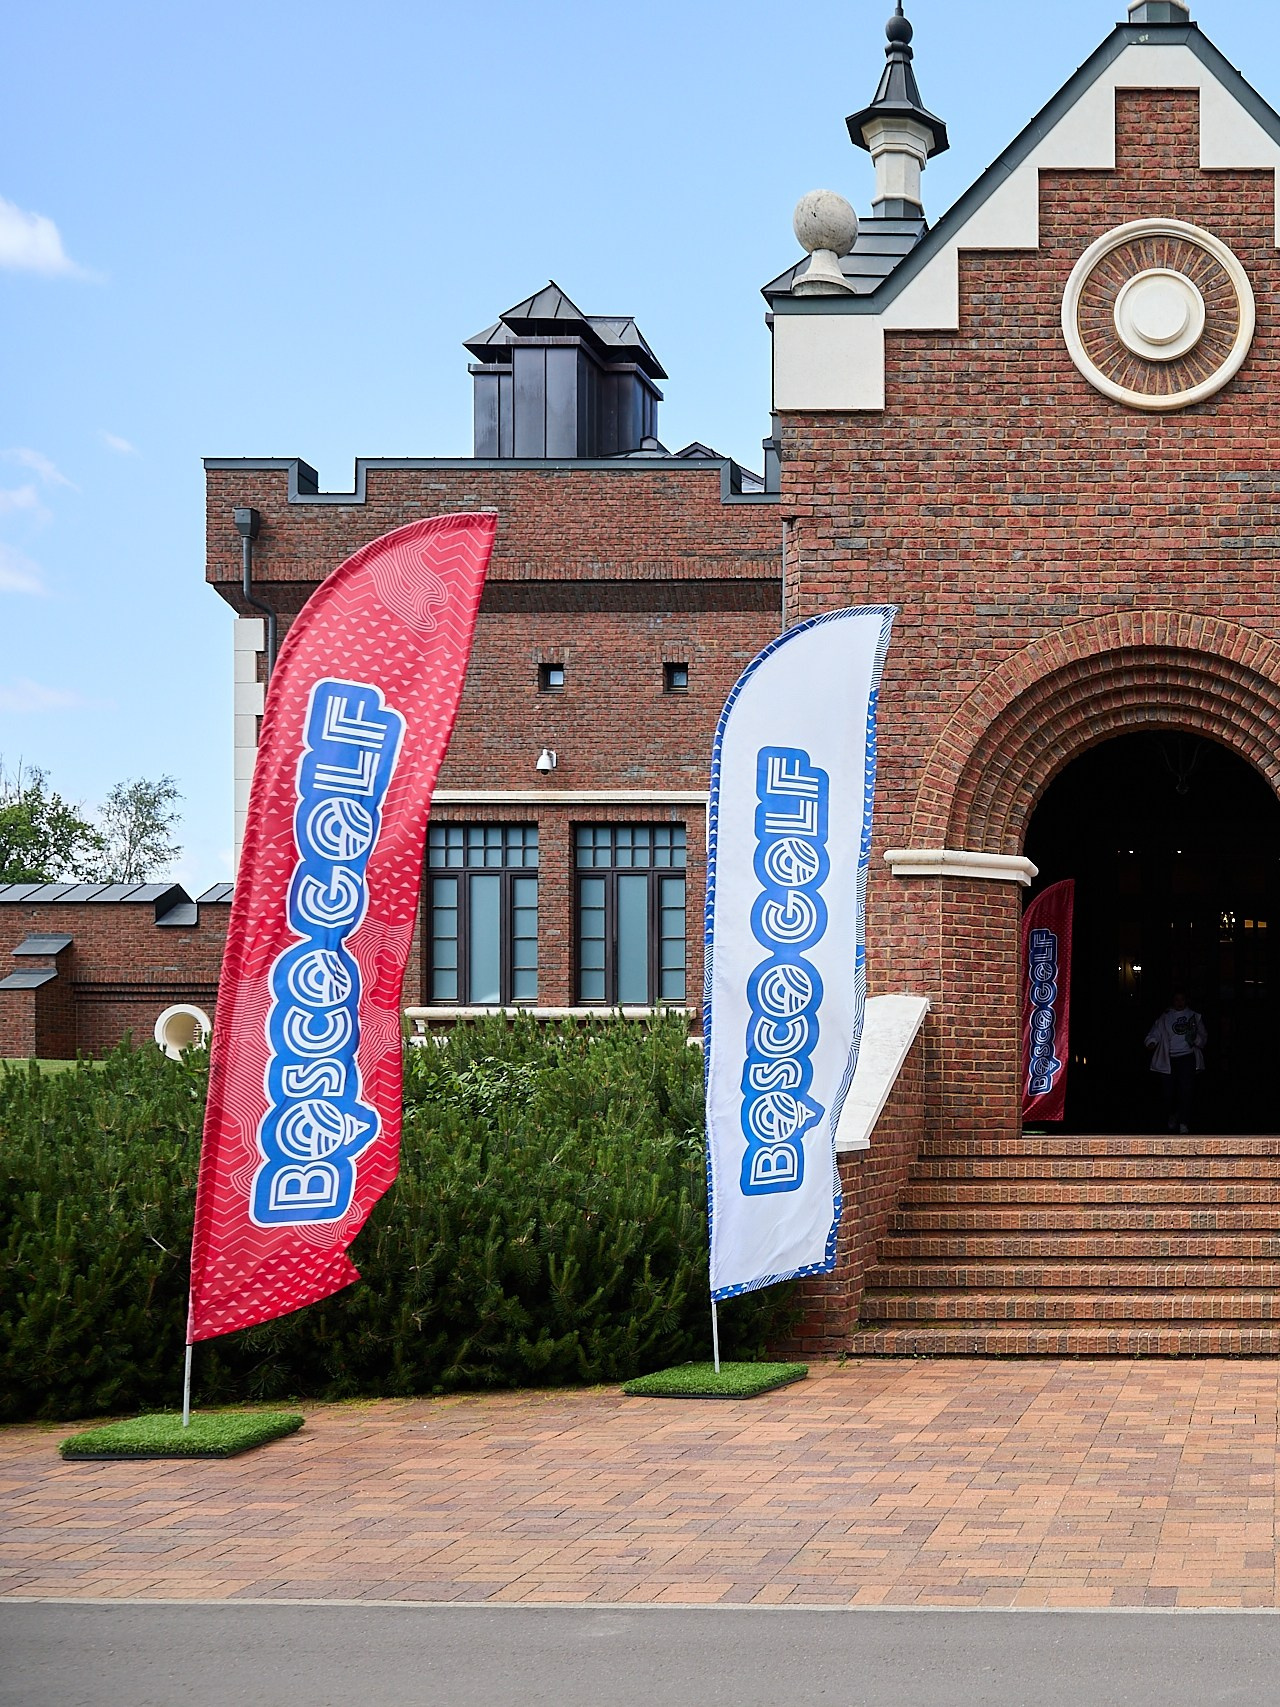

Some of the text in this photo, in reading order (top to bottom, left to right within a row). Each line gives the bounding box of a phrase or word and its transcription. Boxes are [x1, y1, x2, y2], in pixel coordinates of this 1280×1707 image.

[297, 695, 387, 928] GOLF
[761, 757, 820, 944] GOLF
[1034, 934, 1053, 1003] GOLF
